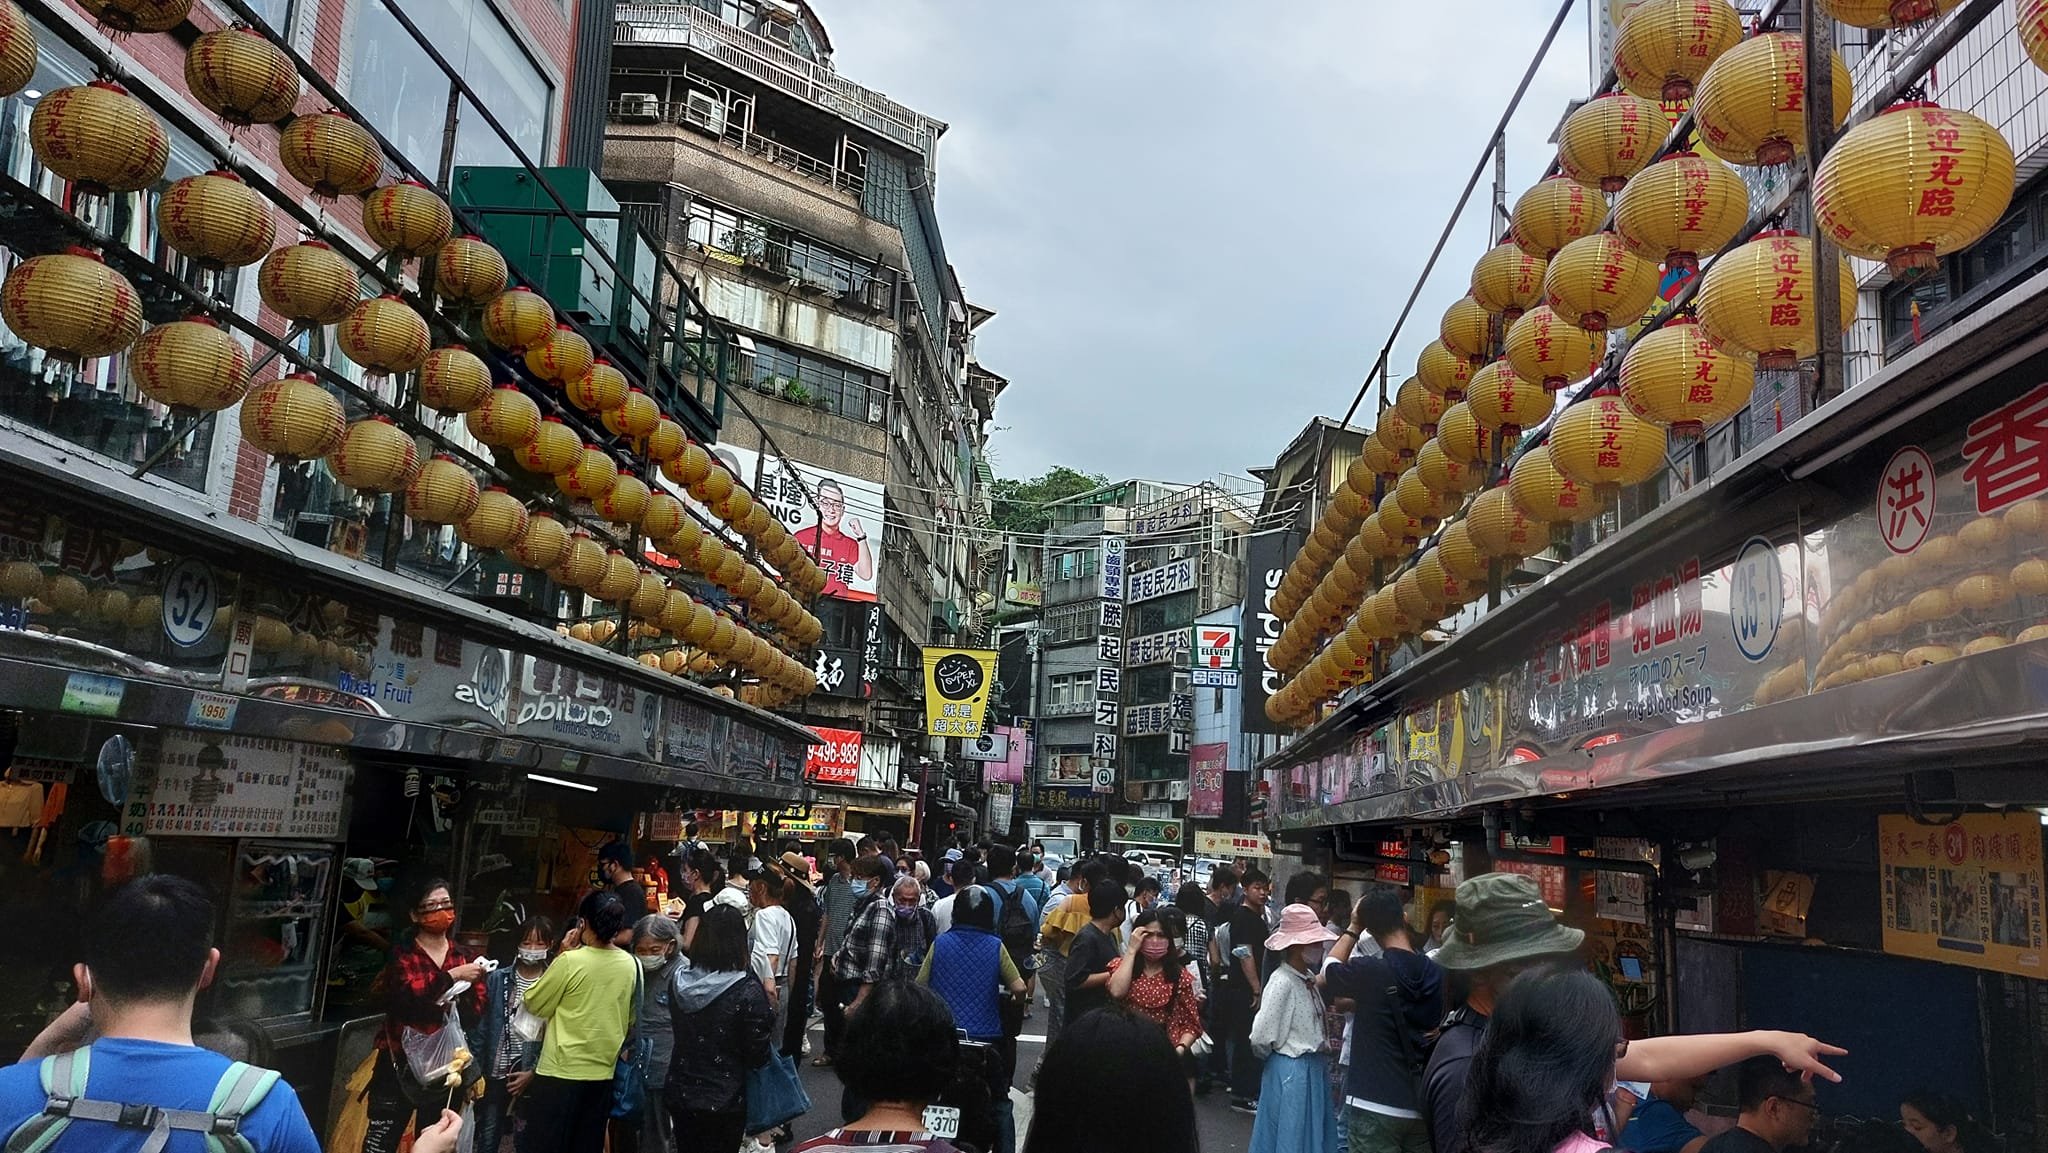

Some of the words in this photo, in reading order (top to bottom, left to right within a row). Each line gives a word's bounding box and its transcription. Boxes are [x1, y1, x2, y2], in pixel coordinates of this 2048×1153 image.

[45, 87, 75, 161] 歡迎光臨
[1916, 110, 1967, 217] 歡迎光臨
[169, 177, 195, 243] 歡迎光臨
[1680, 168, 1710, 232] 開漳聖王
[1597, 240, 1626, 295] 開漳聖王
[1769, 239, 1804, 327] 歡迎光臨
[1533, 313, 1553, 364] 開漳聖王
[1688, 327, 1718, 404] 歡迎光臨
[1596, 400, 1624, 469] 歡迎光臨
[1887, 462, 1928, 541] 洪
[172, 570, 208, 631] 52
[1202, 631, 1231, 668] 7
[200, 702, 227, 719] 1950
[337, 670, 377, 699] Mixed
[384, 681, 414, 705] Fruit
[942, 704, 972, 719] 就是
[1626, 700, 1645, 723] Pig
[1646, 687, 1679, 717] Blood
[1682, 685, 1713, 710] Soup
[933, 718, 979, 735] 超大杯
[125, 822, 145, 835] 40
